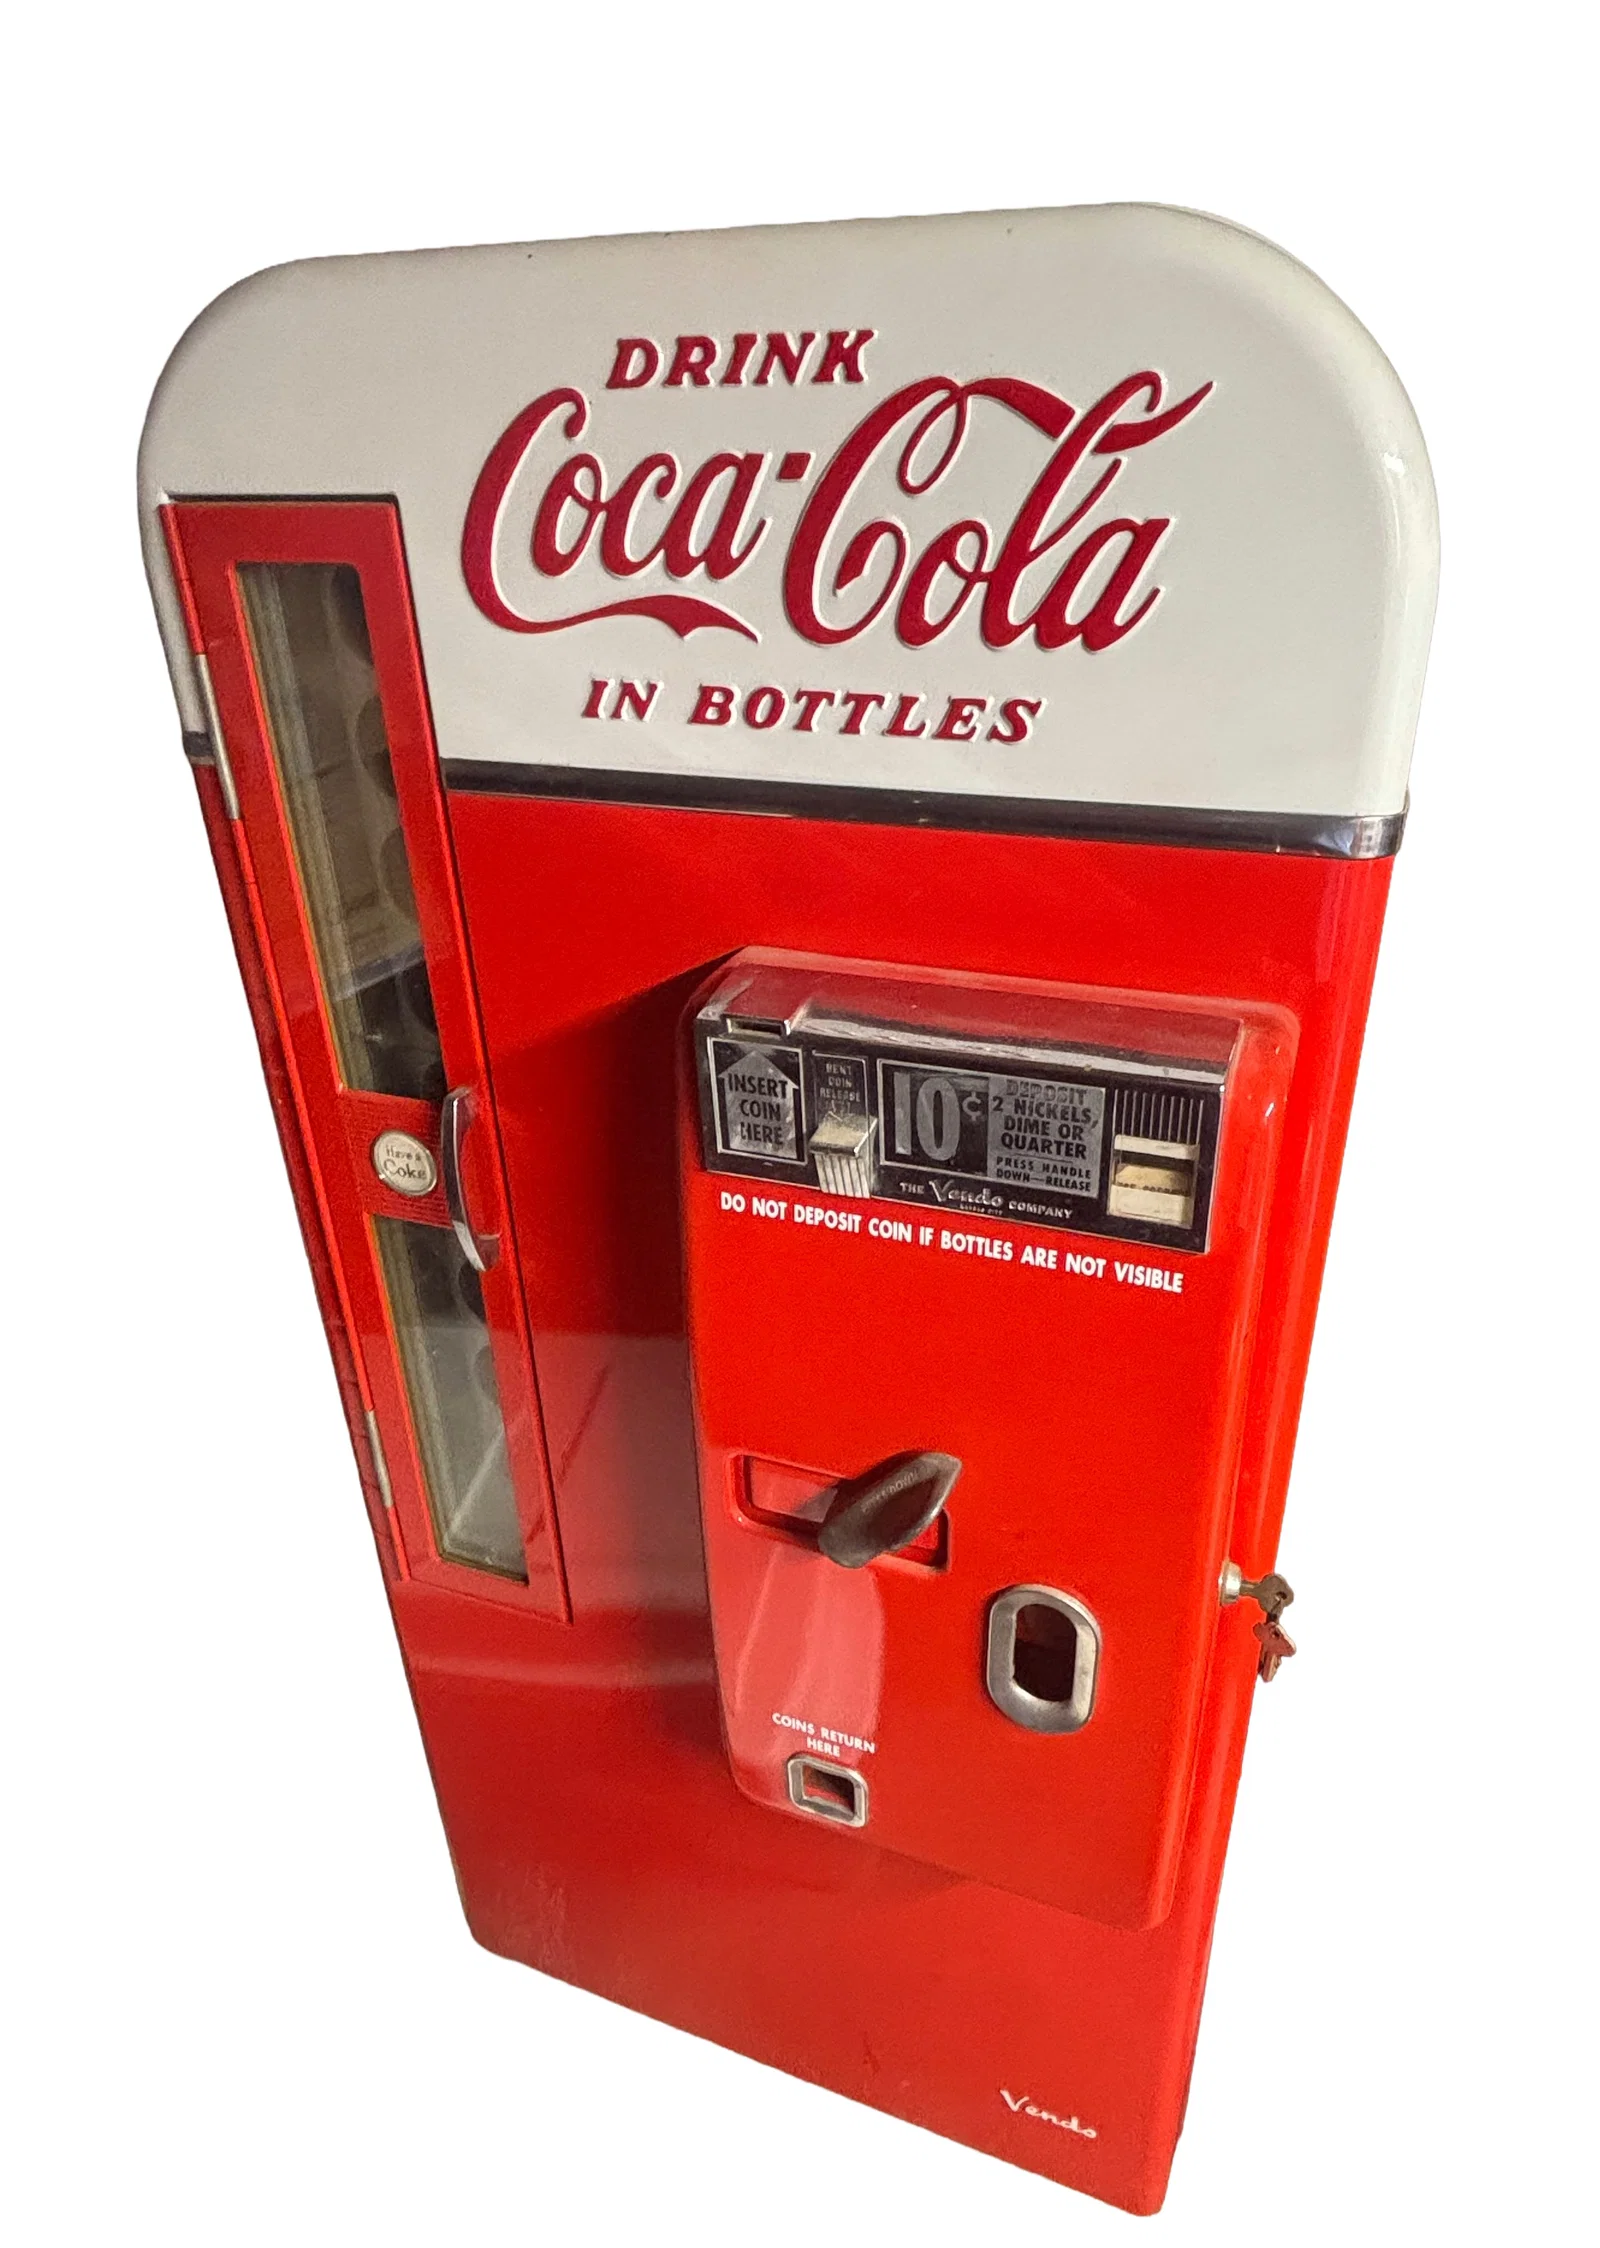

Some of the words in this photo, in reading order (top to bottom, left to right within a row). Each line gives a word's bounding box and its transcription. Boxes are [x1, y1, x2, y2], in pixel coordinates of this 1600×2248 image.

[606, 329, 873, 388] DRINK
[461, 370, 1214, 652] Coca-Cola
[582, 680, 661, 721] IN
[690, 682, 1044, 745] BOTTLES
[728, 1073, 788, 1099] INSERT
[828, 1076, 852, 1088] COIN
[1006, 1079, 1087, 1105] DEPOSIT
[740, 1100, 781, 1120] COIN
[993, 1096, 1004, 1112] 2
[740, 1121, 783, 1146] HERE
[1004, 1115, 1050, 1136] DIME
[1058, 1123, 1085, 1142] OR
[386, 1145, 413, 1160] Have
[1001, 1133, 1087, 1160] QUARTER
[384, 1158, 427, 1180] Coke
[996, 1156, 1034, 1172] PRESS
[1042, 1162, 1091, 1180] HANDLE
[900, 1182, 924, 1194] THE
[929, 1179, 1004, 1208] Vendo
[1008, 1200, 1073, 1219] COMPANY
[721, 1191, 746, 1213] DO
[752, 1197, 787, 1220] NOT
[794, 1205, 862, 1233] DEPOSIT
[868, 1219, 912, 1243] COIN
[919, 1226, 934, 1247] IF
[941, 1230, 1013, 1261] BOTTLES
[1020, 1245, 1058, 1270] ARE
[1065, 1252, 1106, 1278] NOT
[1114, 1261, 1184, 1293] VISIBLE
[772, 1712, 815, 1735] COINS
[821, 1727, 875, 1753] RETURN
[806, 1737, 840, 1757] HERE
[1000, 2089, 1097, 2139] Vendo
